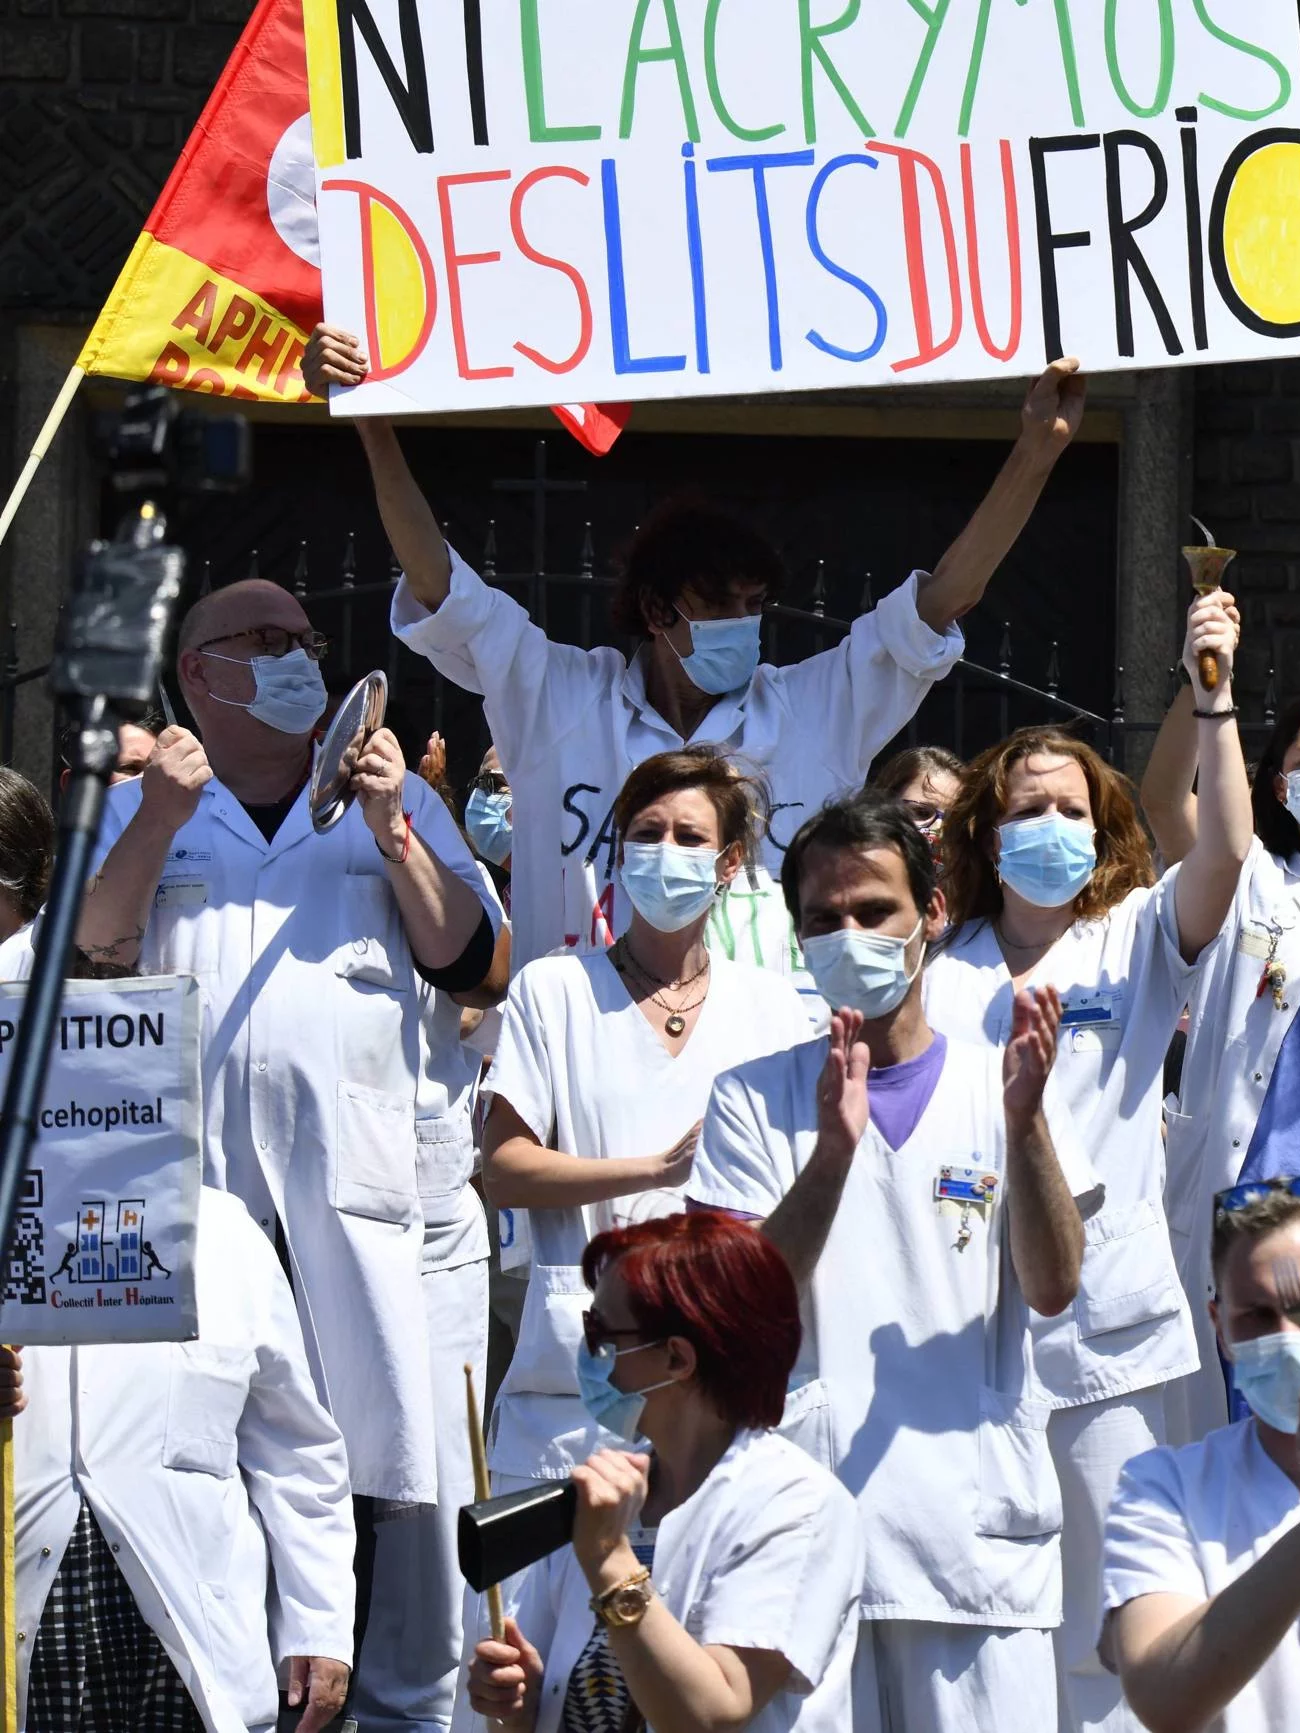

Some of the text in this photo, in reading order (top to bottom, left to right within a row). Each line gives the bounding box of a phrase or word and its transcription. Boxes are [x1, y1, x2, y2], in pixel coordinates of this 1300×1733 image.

[322, 165, 593, 388] DES
[864, 139, 1022, 374] DU
[50, 1290, 95, 1309] Collectif
[96, 1288, 123, 1307] Inter
